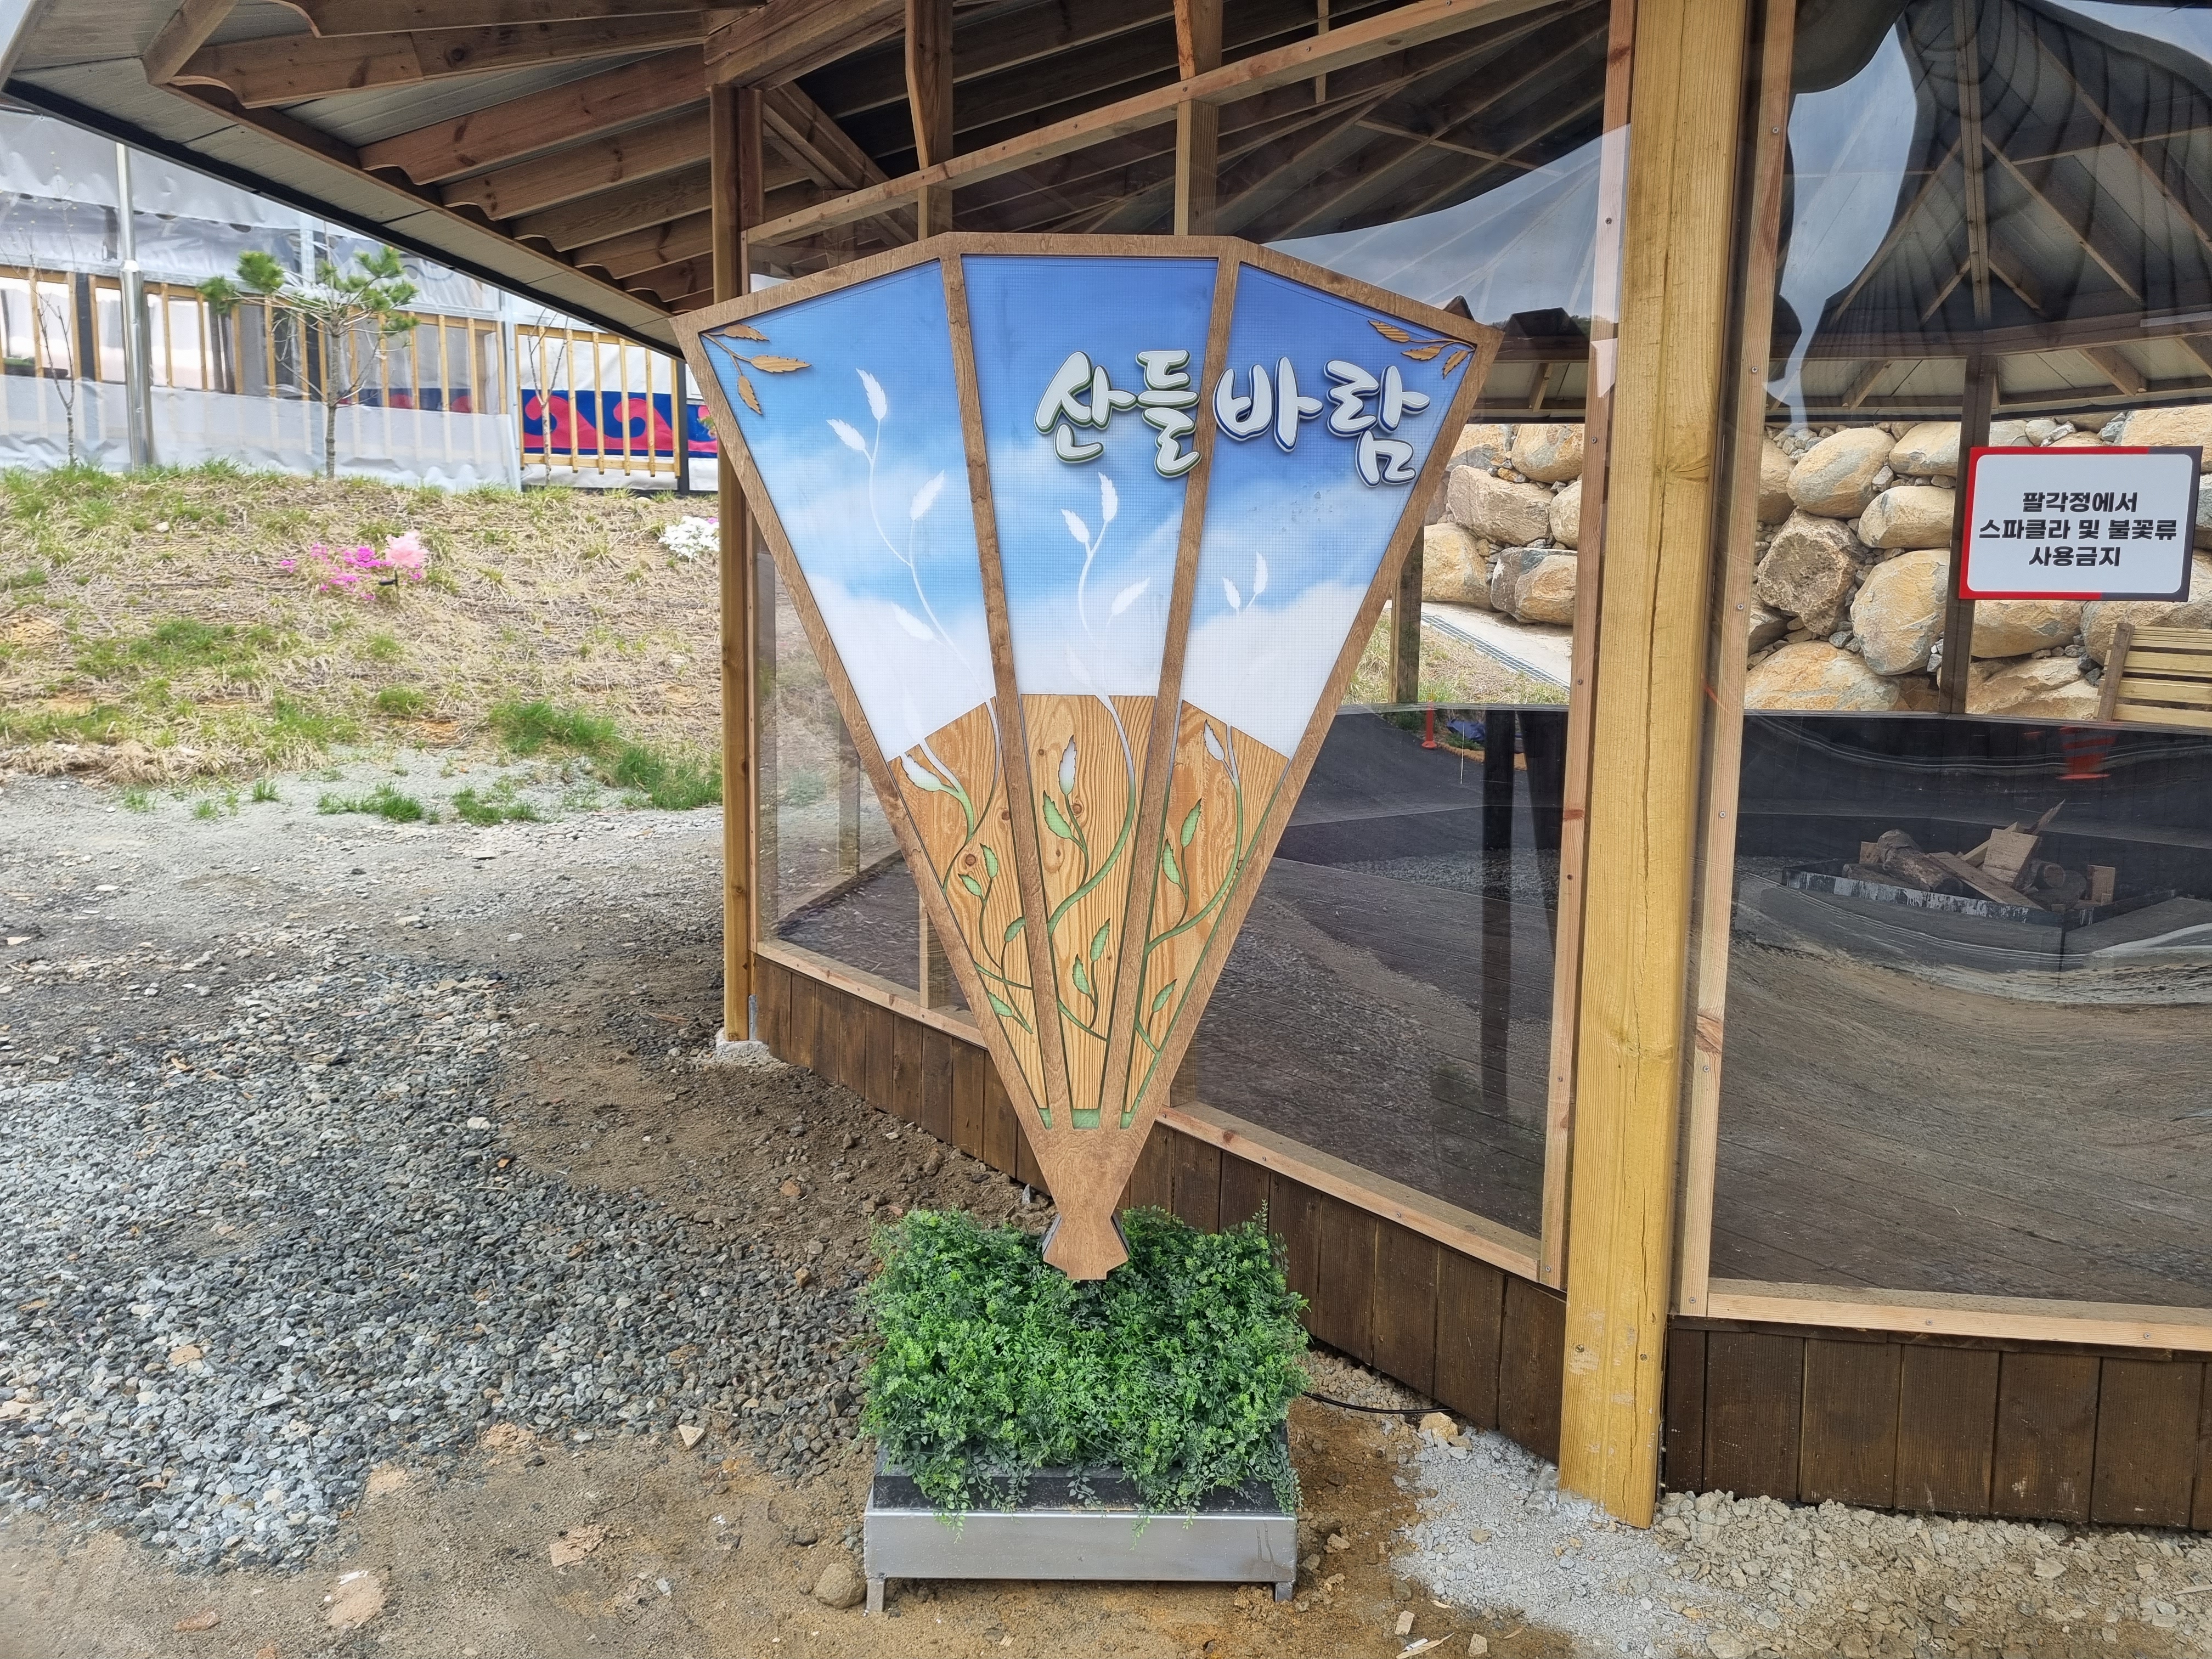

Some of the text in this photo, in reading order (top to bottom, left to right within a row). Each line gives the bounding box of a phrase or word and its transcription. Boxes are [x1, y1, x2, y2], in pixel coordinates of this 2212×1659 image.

[2022, 492, 2138, 513] 팔각정에서
[1979, 519, 2177, 540] 스파클라 및 불꽃류
[2028, 546, 2121, 567] 사용금지
